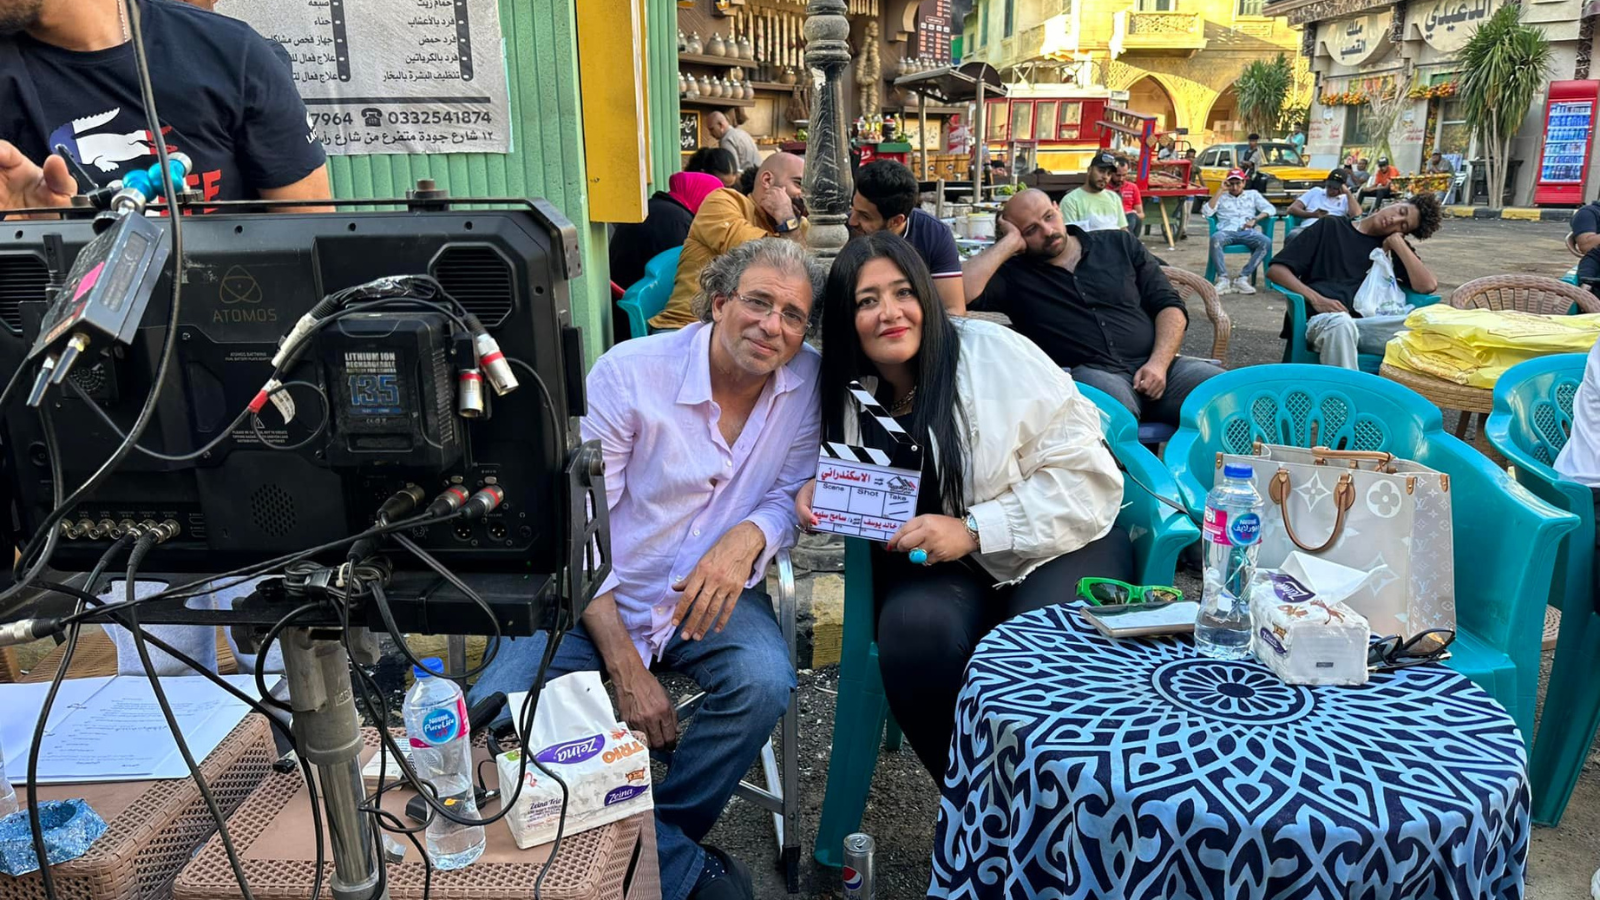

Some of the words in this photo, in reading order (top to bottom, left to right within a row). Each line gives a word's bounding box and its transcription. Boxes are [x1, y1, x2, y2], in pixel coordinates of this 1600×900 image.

[314, 17, 331, 26] حناء
[388, 110, 492, 125] 0332541874
[335, 131, 361, 146] شارع
[364, 132, 379, 145] من
[382, 130, 416, 145] متفرع
[418, 131, 449, 144] جودة
[451, 129, 478, 144] شارع
[212, 308, 277, 323] ATOMOS
[344, 352, 379, 361] LITHIUM
[380, 352, 396, 361] ION
[348, 374, 400, 406] 135
[822, 483, 845, 492] Scene
[857, 488, 879, 498] Shot
[889, 493, 907, 501] Take
[555, 738, 598, 762] Zeina
[602, 741, 644, 764] TRIO
[608, 789, 633, 804] Zeina
